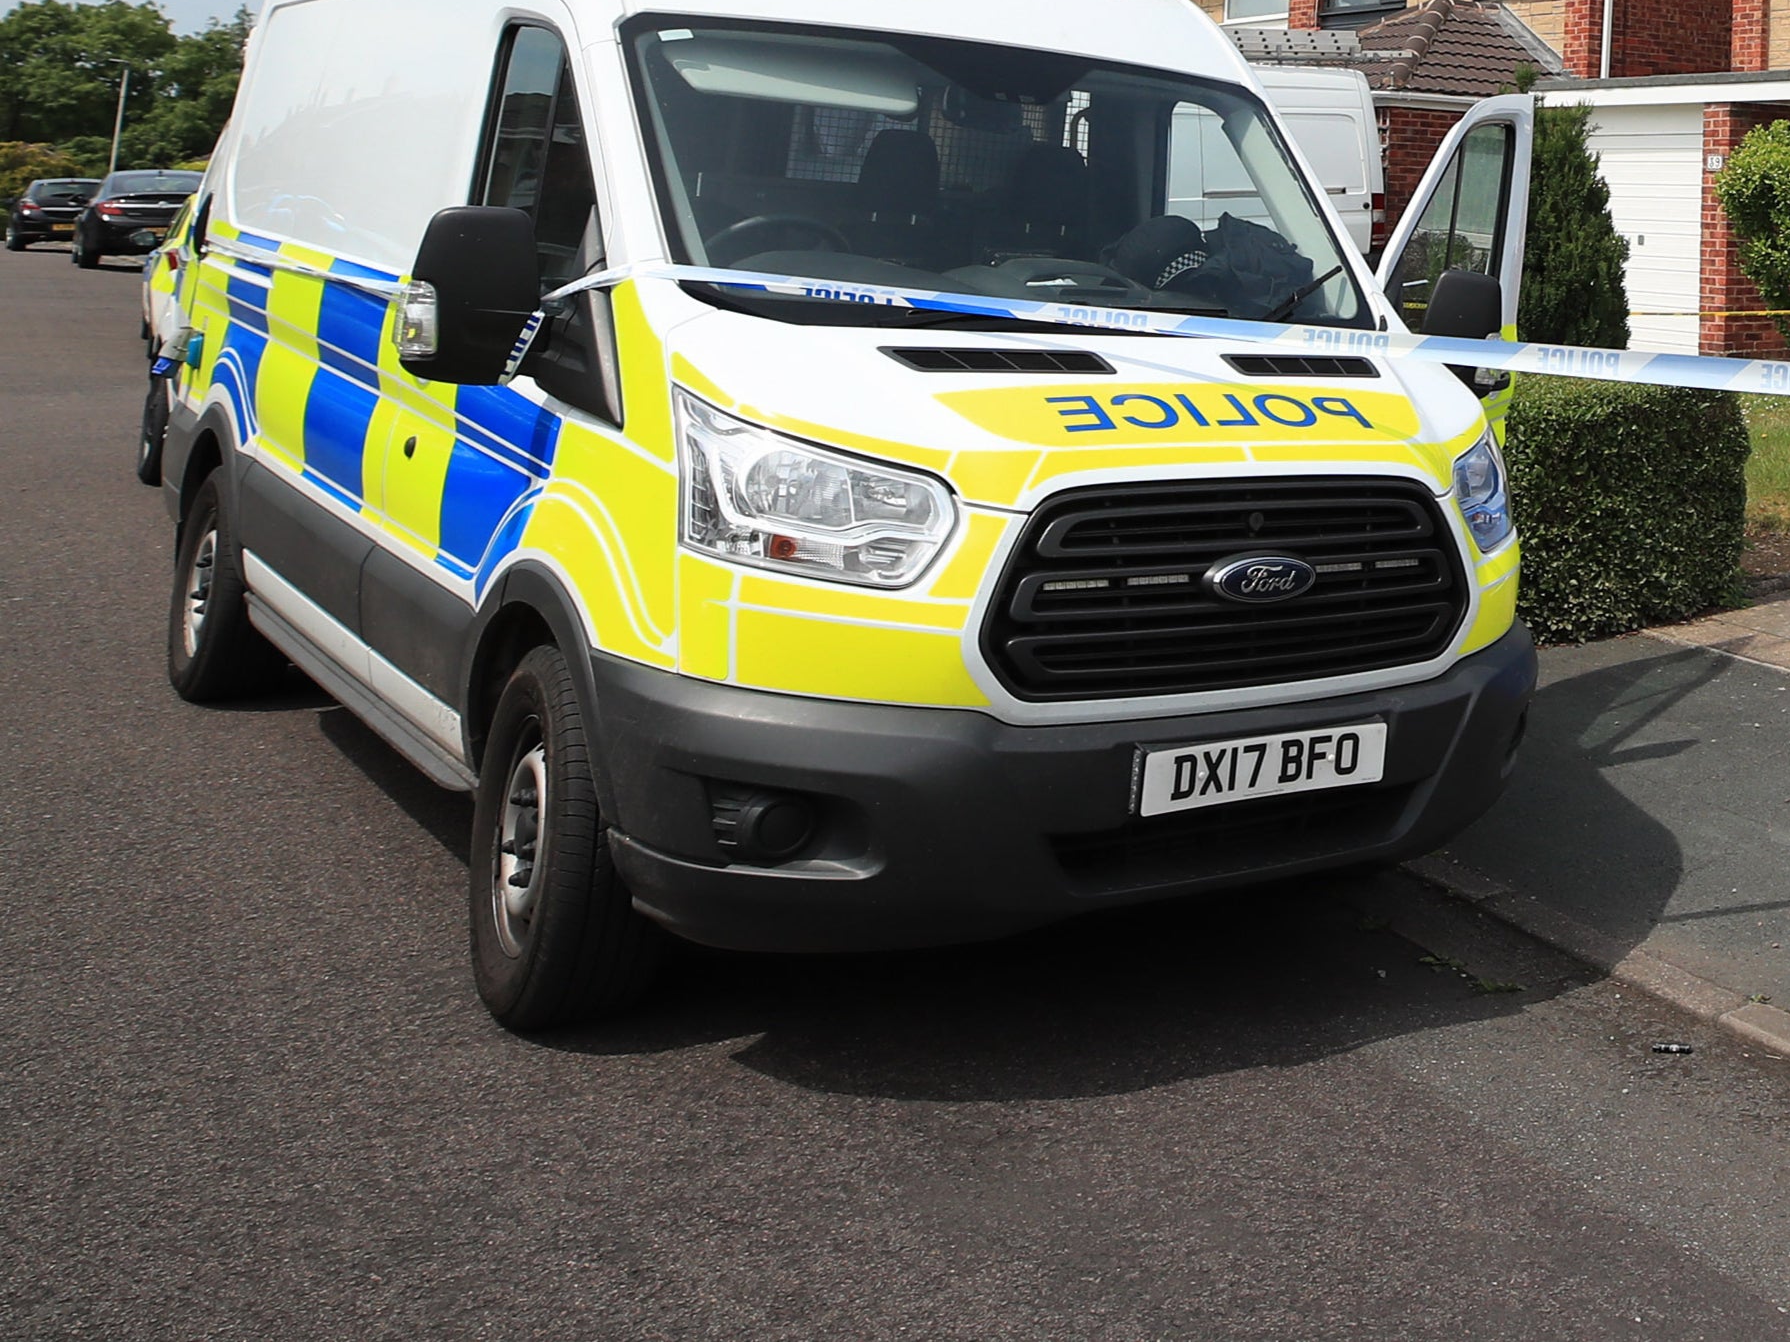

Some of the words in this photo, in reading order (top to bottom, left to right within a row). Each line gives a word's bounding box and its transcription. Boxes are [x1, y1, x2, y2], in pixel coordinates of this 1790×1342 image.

[1241, 565, 1296, 593] Ford
[1170, 742, 1267, 801] DX17
[1278, 732, 1360, 784] BFO
